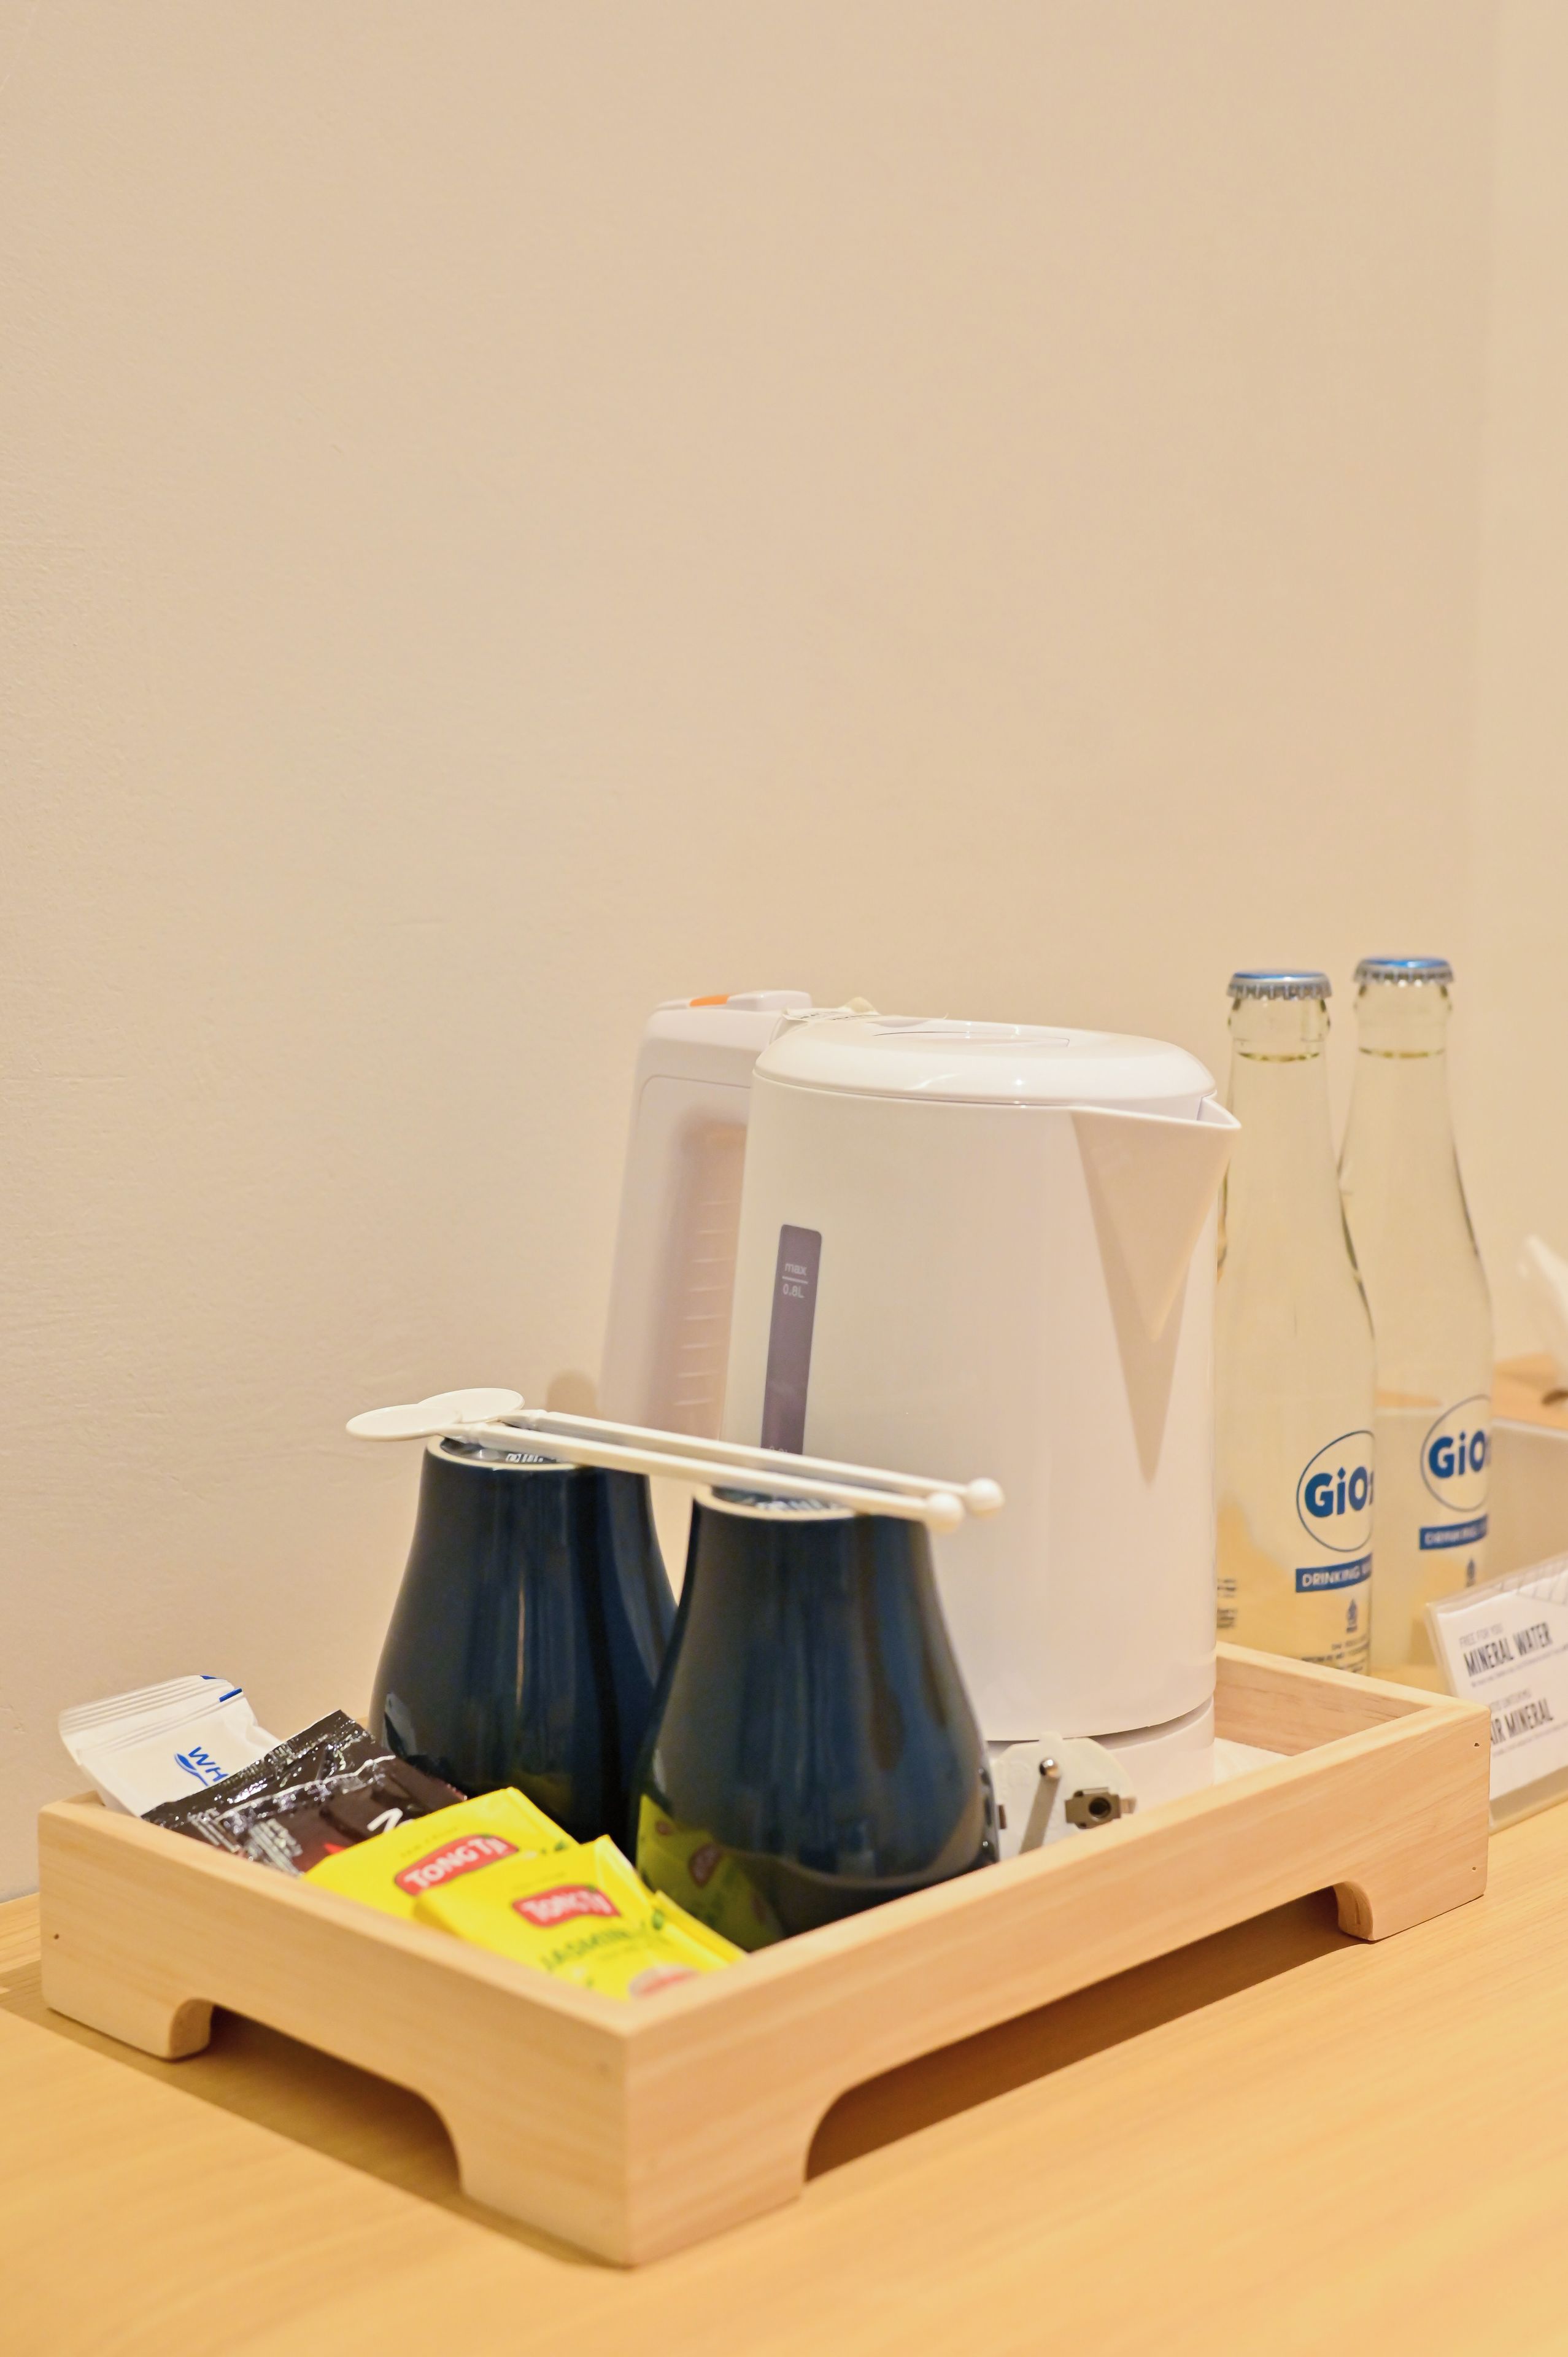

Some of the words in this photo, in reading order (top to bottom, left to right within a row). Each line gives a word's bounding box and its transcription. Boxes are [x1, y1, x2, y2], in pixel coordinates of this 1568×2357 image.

[785, 1263, 807, 1276] max
[1302, 1565, 1361, 1588] DRINKING
[1464, 1637, 1514, 1677] MINERAL
[1513, 1621, 1553, 1656] WATER
[1504, 1698, 1554, 1738] MINERAL
[403, 1844, 480, 1889] TONG
